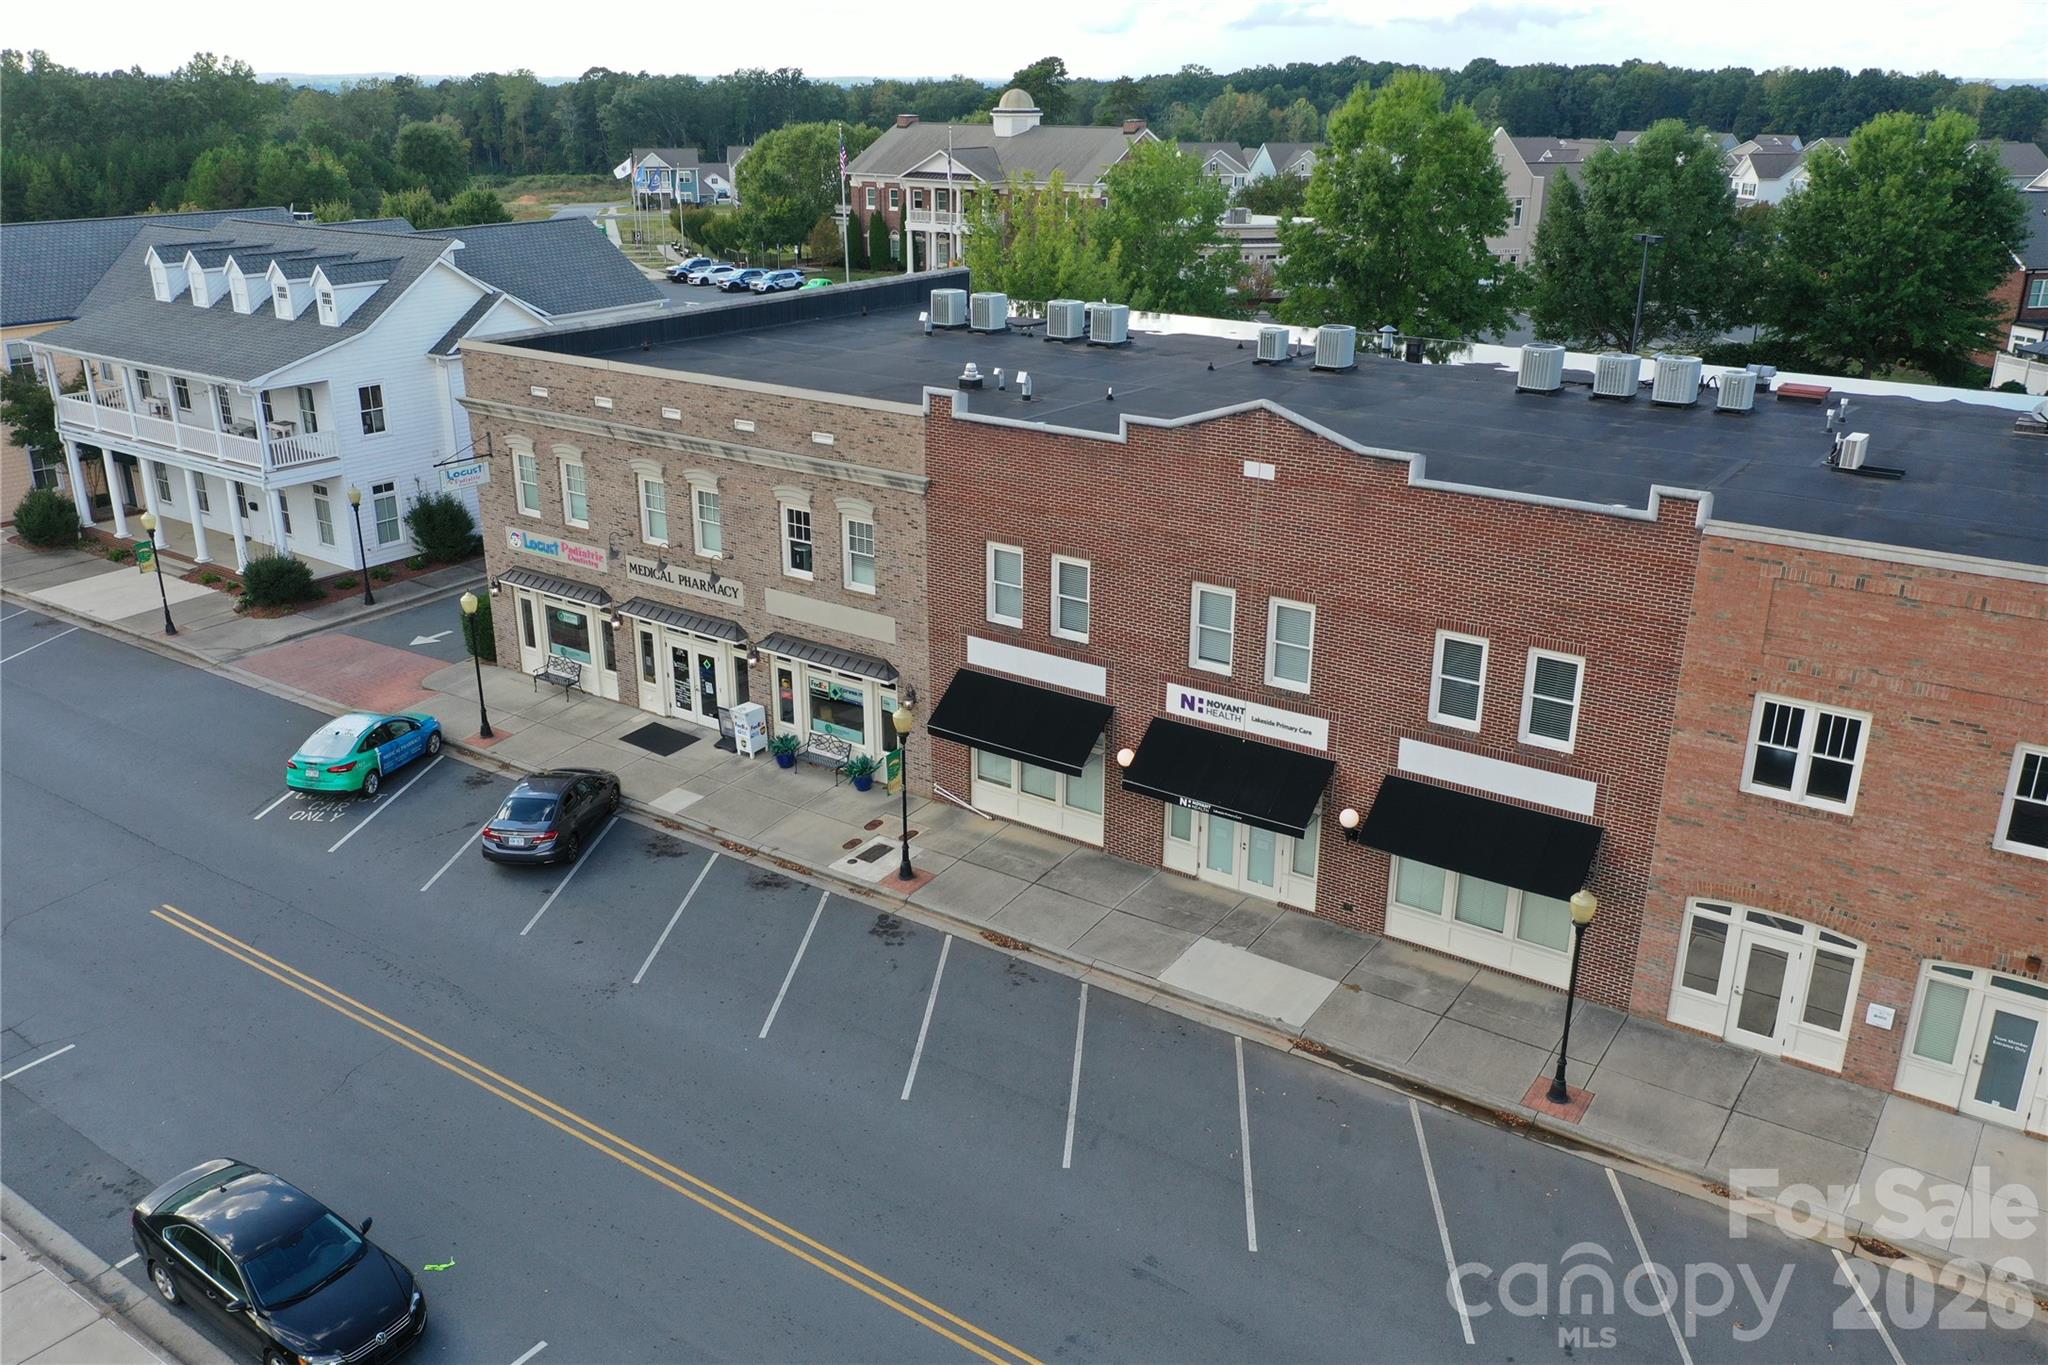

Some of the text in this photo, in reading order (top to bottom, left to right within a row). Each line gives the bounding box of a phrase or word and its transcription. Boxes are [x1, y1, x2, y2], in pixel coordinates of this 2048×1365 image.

[629, 562, 739, 599] MEDICAL PHARMACY
[1206, 699, 1246, 715] NOVANT
[1206, 707, 1242, 723] HEALTH
[1251, 715, 1313, 736] Lakeside Primary Care
[308, 801, 350, 812] CAR
[289, 810, 345, 822] ONLY
